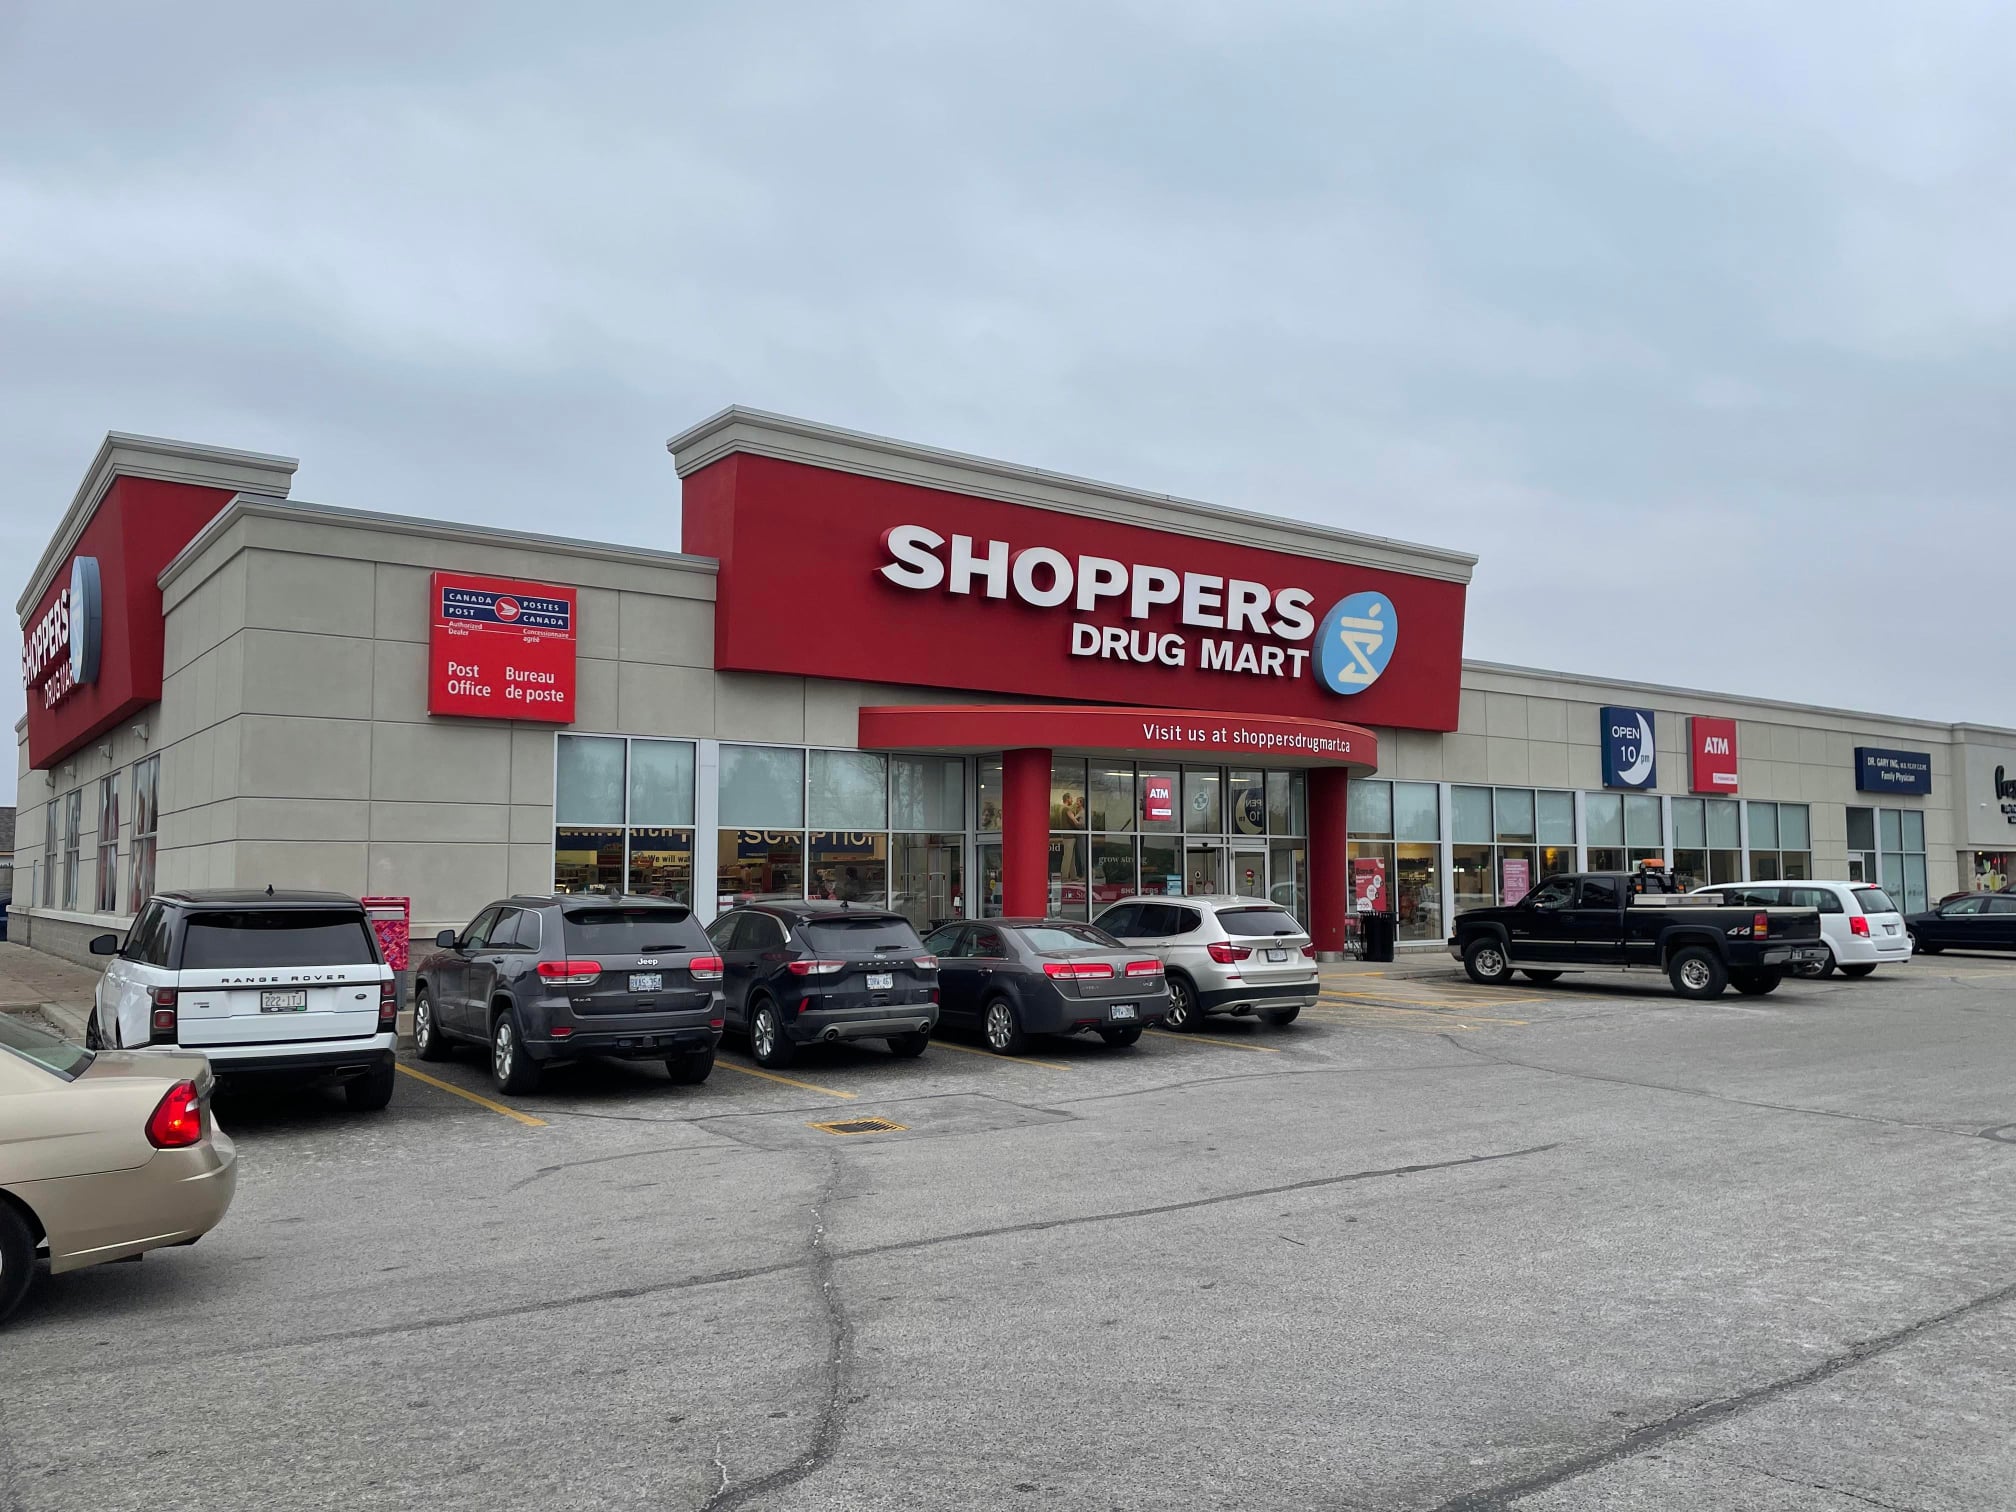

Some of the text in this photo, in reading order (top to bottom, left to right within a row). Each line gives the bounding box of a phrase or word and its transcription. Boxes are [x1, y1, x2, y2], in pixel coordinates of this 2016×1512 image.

[881, 525, 1315, 641] SHOPPERS
[449, 592, 492, 604] CANADA
[449, 607, 475, 616] POST
[523, 601, 560, 611] POSTES
[448, 621, 483, 630] Authorized
[523, 615, 564, 626] CANADA
[448, 628, 469, 636] Dealer
[22, 588, 69, 690] SHOPPERS
[1072, 622, 1310, 678] DRUG MART
[448, 661, 479, 678] Post
[506, 666, 555, 684] Bureau
[448, 680, 491, 697] Office
[505, 684, 564, 703] de poste
[1143, 723, 1350, 753] Visit us at shoppersdrugmart.ca
[1611, 726, 1640, 740] OPEN
[1704, 736, 1729, 755] ATM
[1620, 745, 1650, 764] 10 pm
[1881, 770, 1895, 783] Family
[1149, 788, 1169, 799] ATM
[662, 854, 676, 863] will
[1098, 856, 1119, 865] grow
[637, 958, 658, 966] Jeep
[221, 974, 346, 984] RANGE ROVER
